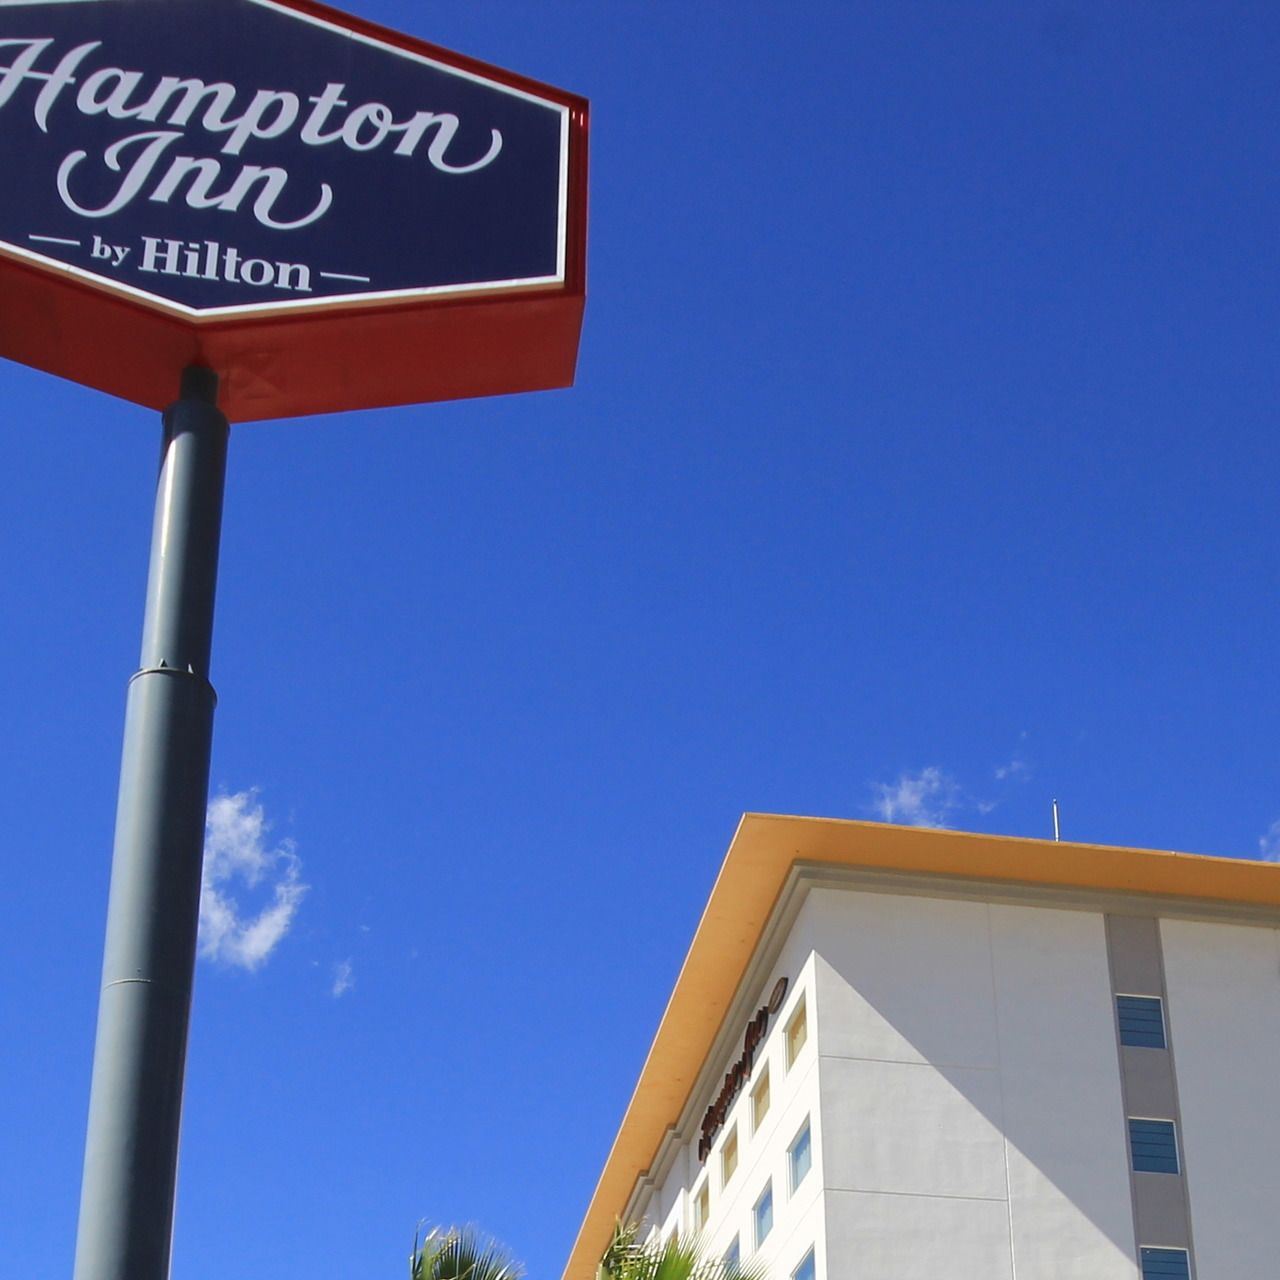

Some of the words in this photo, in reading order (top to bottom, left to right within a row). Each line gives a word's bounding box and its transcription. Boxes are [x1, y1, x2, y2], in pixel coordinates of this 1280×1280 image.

[57, 130, 332, 230] Inn
[90, 234, 130, 267] by
[138, 235, 312, 292] Hilton
